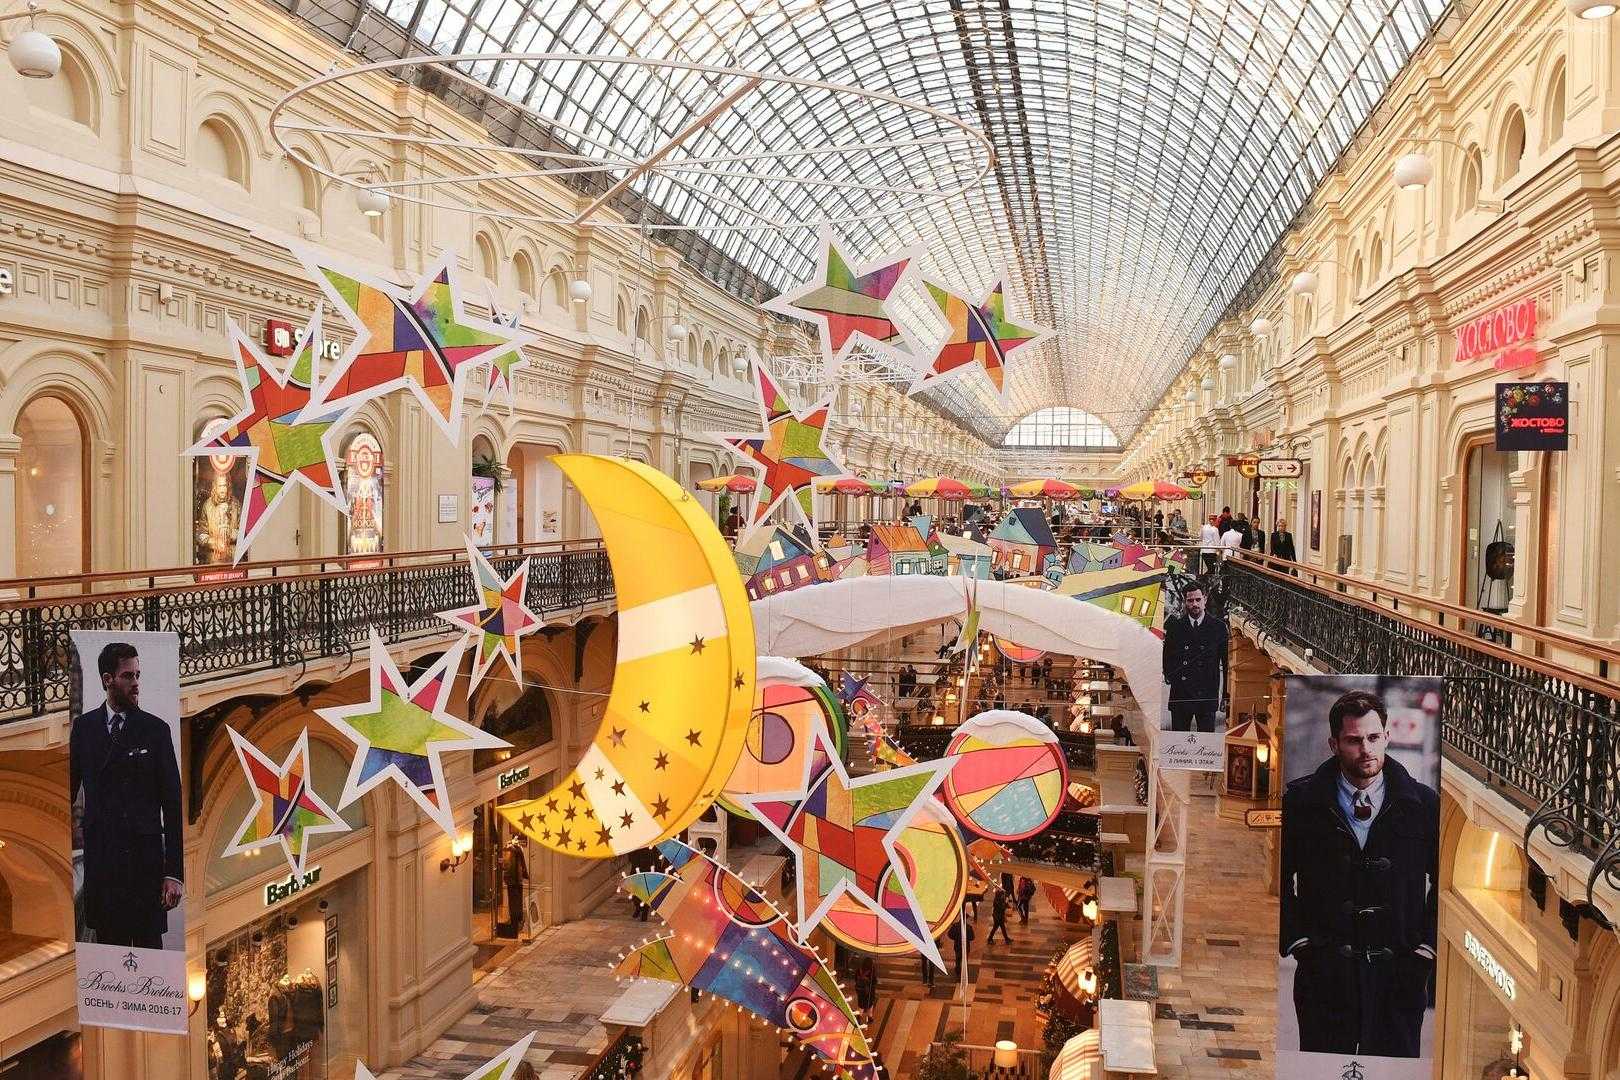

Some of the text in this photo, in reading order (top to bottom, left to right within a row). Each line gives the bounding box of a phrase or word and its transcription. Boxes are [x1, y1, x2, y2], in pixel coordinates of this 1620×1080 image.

[1455, 302, 1531, 362] ЖОСТОВО
[1511, 418, 1565, 428] ЖОСТОВО
[499, 766, 530, 789] Barbour
[79, 970, 184, 999] Brooks Brothers
[84, 997, 114, 1009] ОСЕНЬ
[122, 1001, 147, 1013] ЗИМА
[148, 1004, 182, 1016] 2016-17
